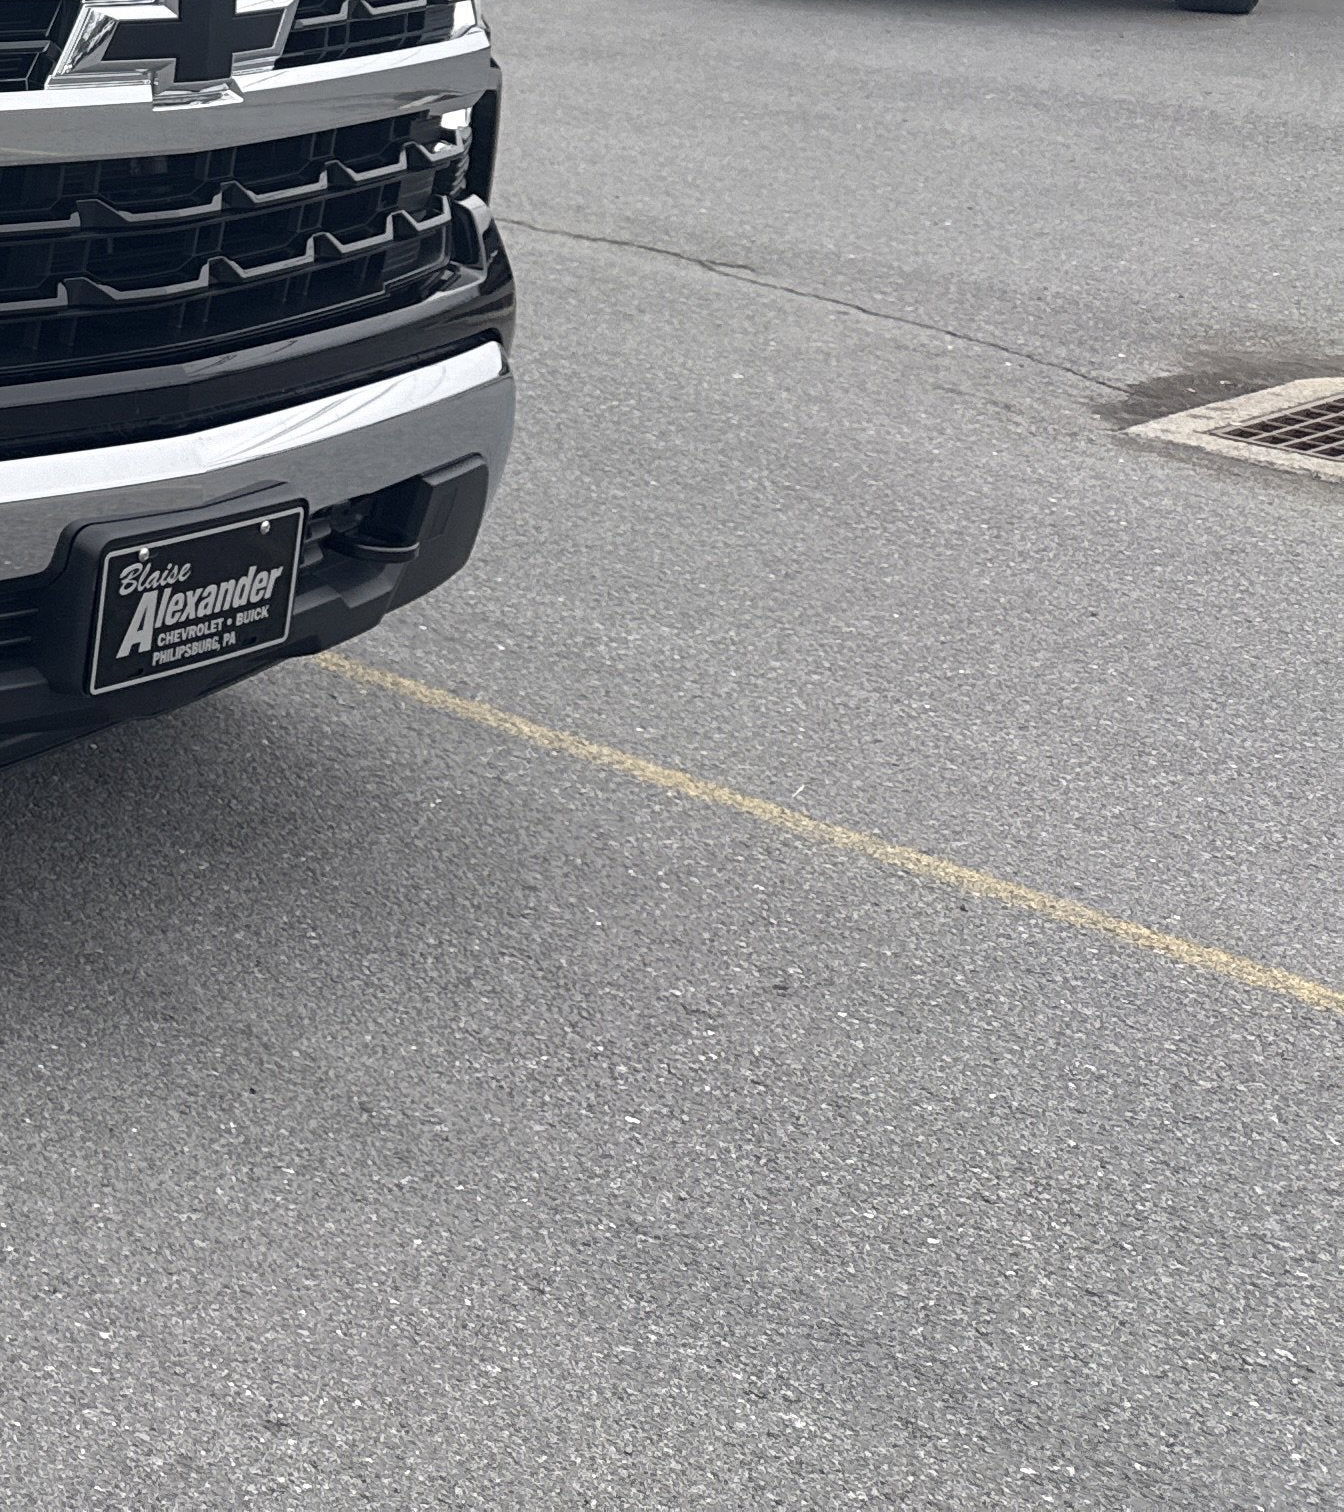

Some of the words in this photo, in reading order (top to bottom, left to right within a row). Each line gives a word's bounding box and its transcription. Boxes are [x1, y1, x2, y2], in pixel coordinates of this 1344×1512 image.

[119, 563, 192, 596] Blaise
[115, 565, 284, 659] Alexander
[157, 618, 225, 647] CHEVROLET
[235, 605, 270, 626] BUICK
[152, 641, 221, 667] PHILIPSBURG,
[222, 631, 237, 646] PA
